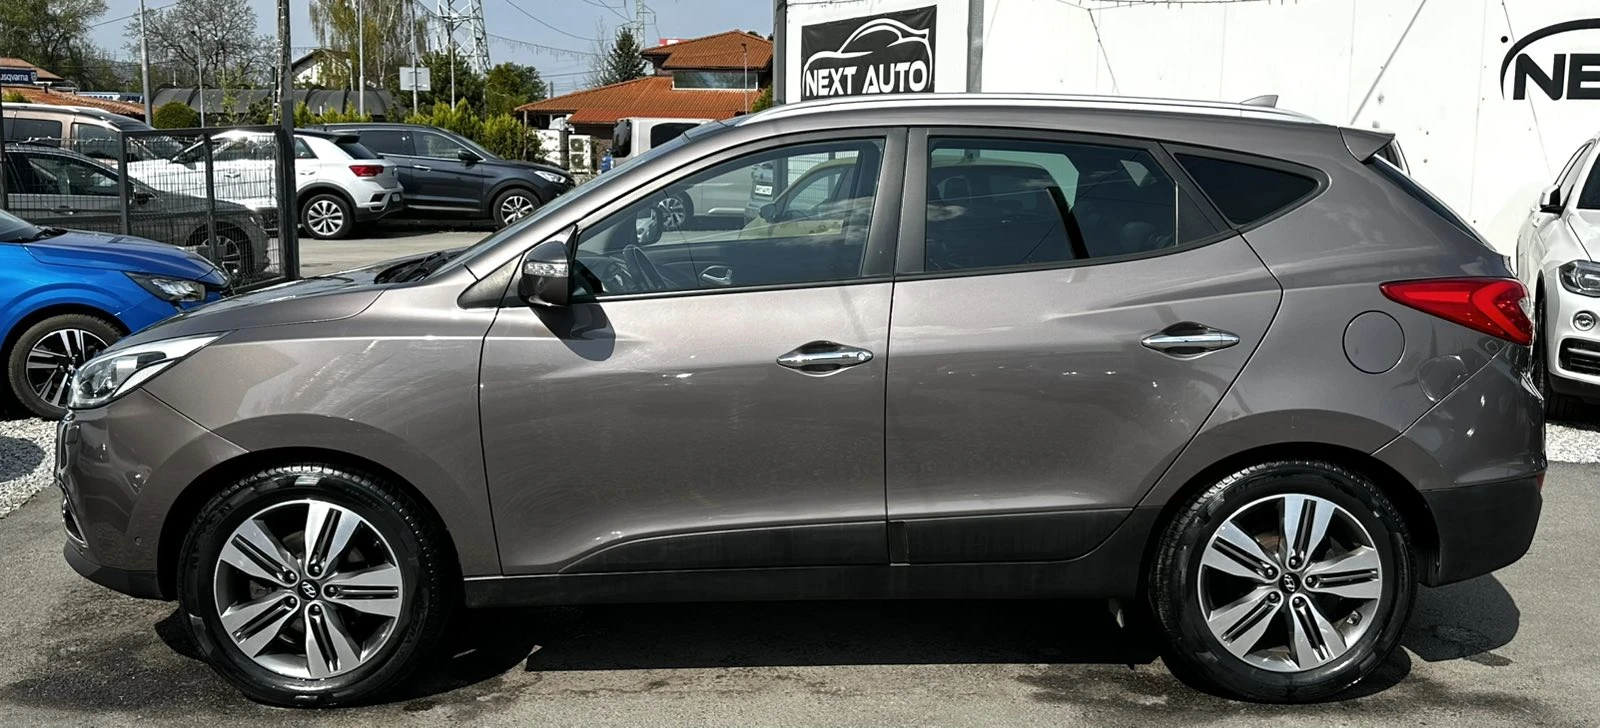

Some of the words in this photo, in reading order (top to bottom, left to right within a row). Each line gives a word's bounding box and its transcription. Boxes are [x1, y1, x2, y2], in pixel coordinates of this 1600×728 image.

[805, 66, 857, 97] NEXT
[861, 60, 928, 94] AUTO
[1513, 53, 1600, 101] NE
